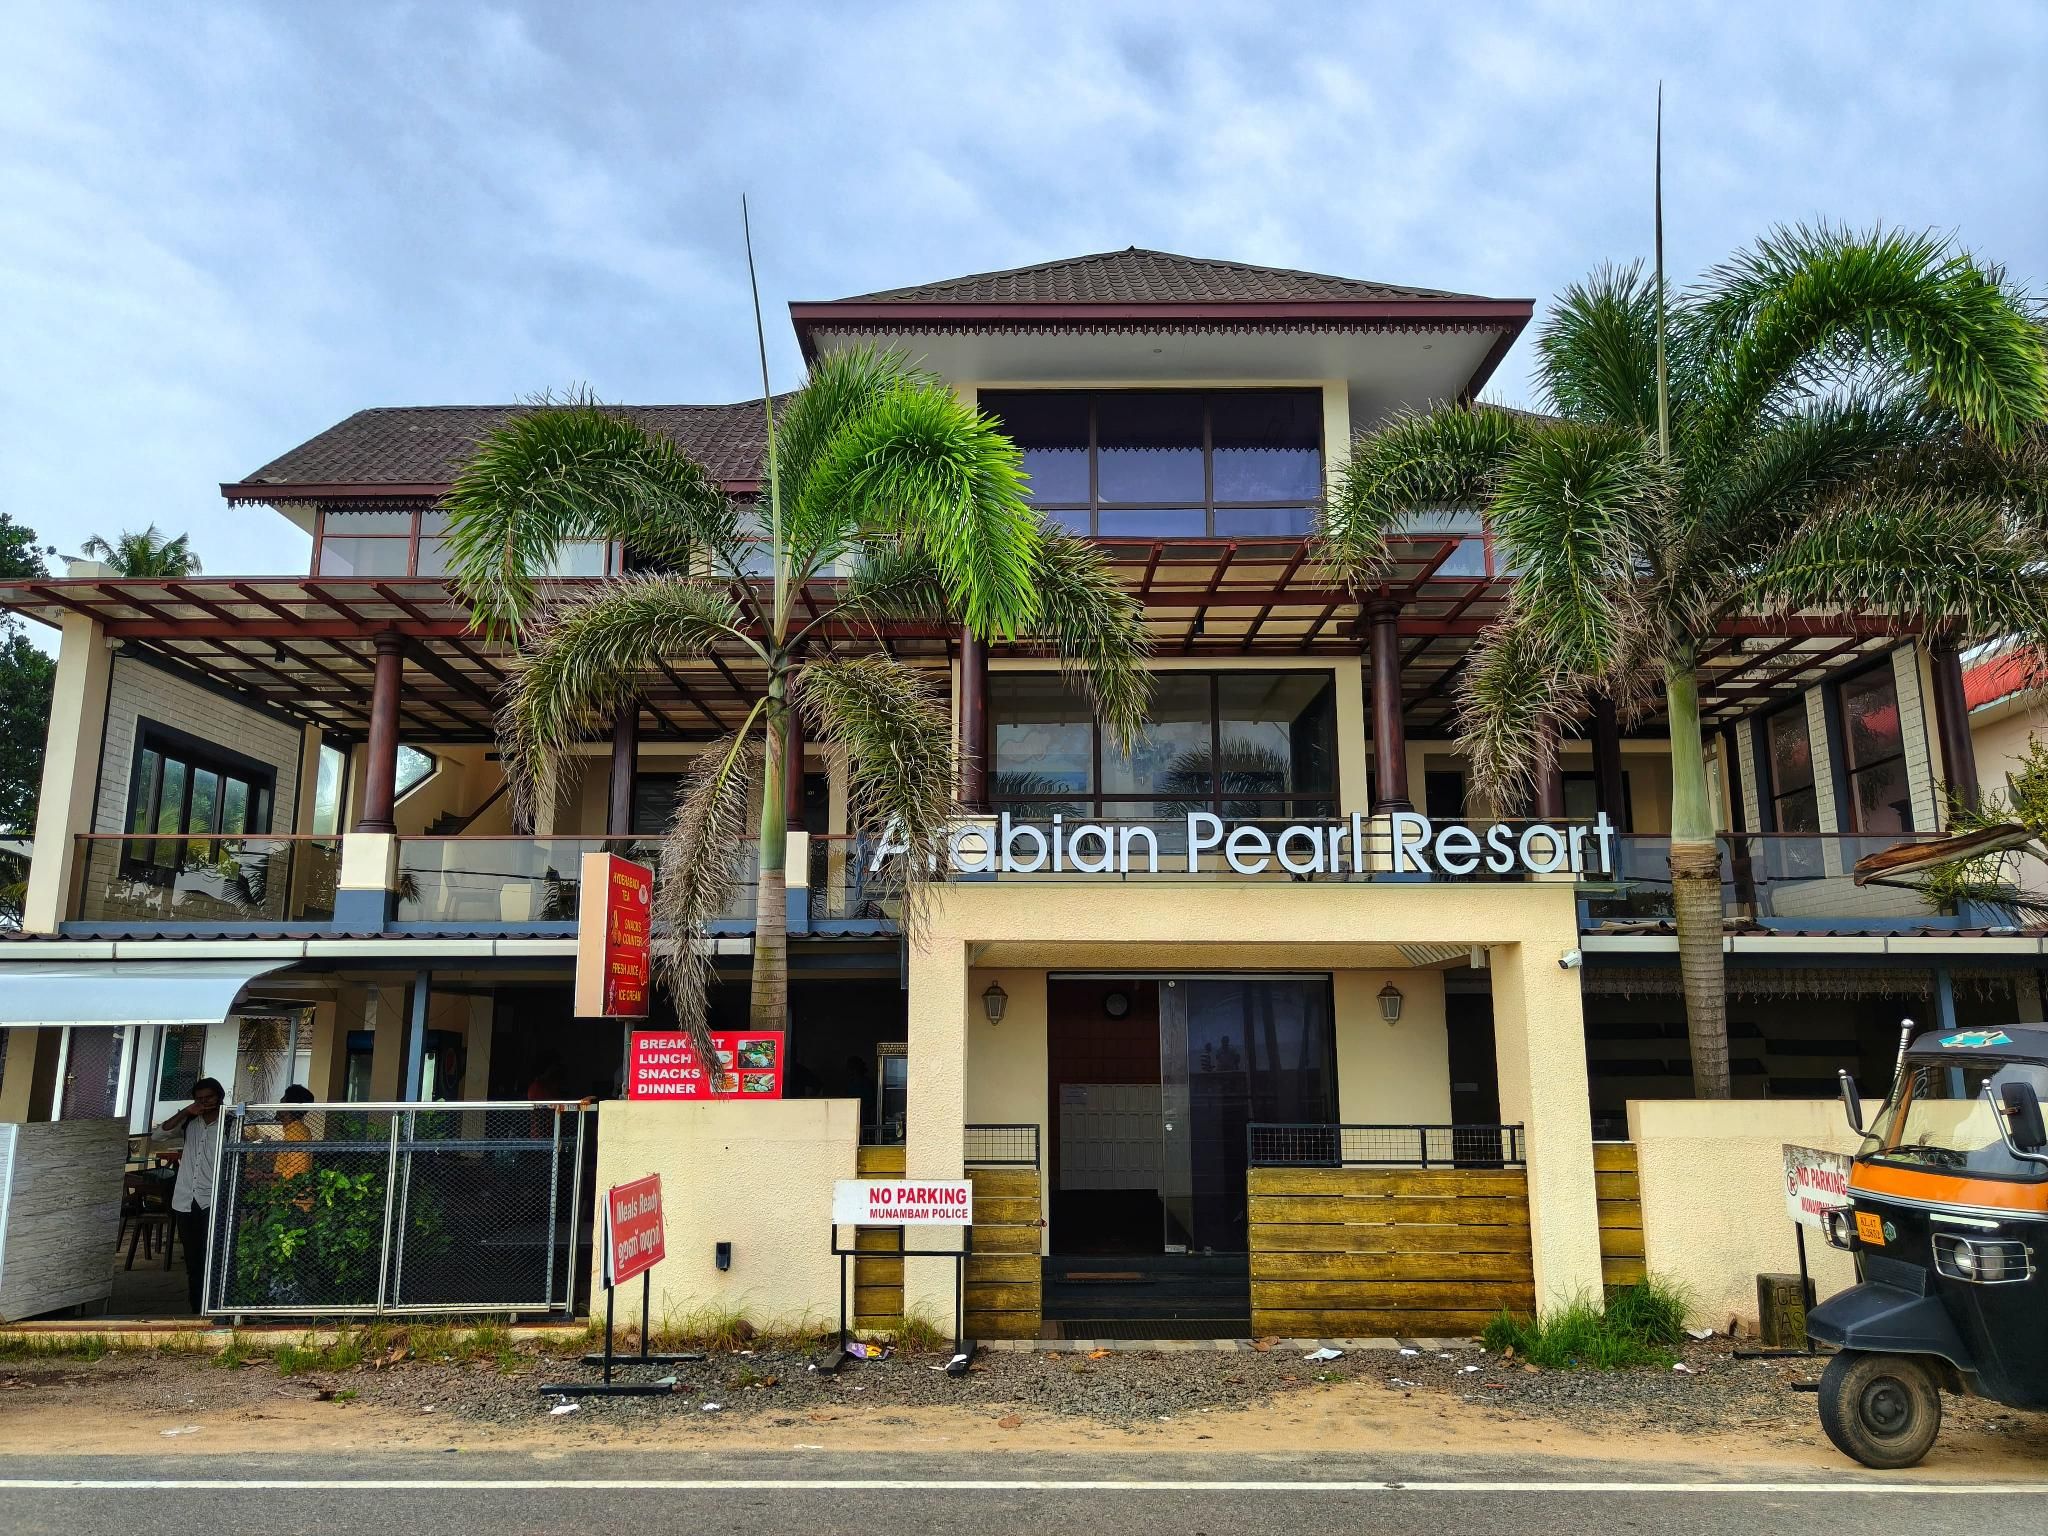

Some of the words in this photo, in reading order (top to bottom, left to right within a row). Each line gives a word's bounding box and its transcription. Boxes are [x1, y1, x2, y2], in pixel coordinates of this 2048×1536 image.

[1187, 812, 1362, 874] Pearl
[1393, 812, 1614, 874] Resort
[622, 889, 631, 902] TEA
[624, 919, 642, 932] SNACKS
[622, 933, 643, 947] COUNTER
[612, 962, 626, 975] FRESH
[627, 964, 639, 976] JUICE
[618, 989, 626, 1001] ICE
[627, 990, 641, 1002] CREAM
[639, 1053, 692, 1064] LUNCH
[638, 1068, 701, 1079] SNACKS
[637, 1083, 696, 1094] DINNER
[1796, 1166, 1809, 1187] NO
[1811, 1168, 1848, 1195] PARKING
[869, 1188, 892, 1204] NO
[897, 1188, 967, 1205] PARKING
[616, 1196, 638, 1225] Meals
[639, 1188, 659, 1214] Ready
[869, 1208, 929, 1219] MUNAMBAM
[932, 1208, 968, 1219] POLICE
